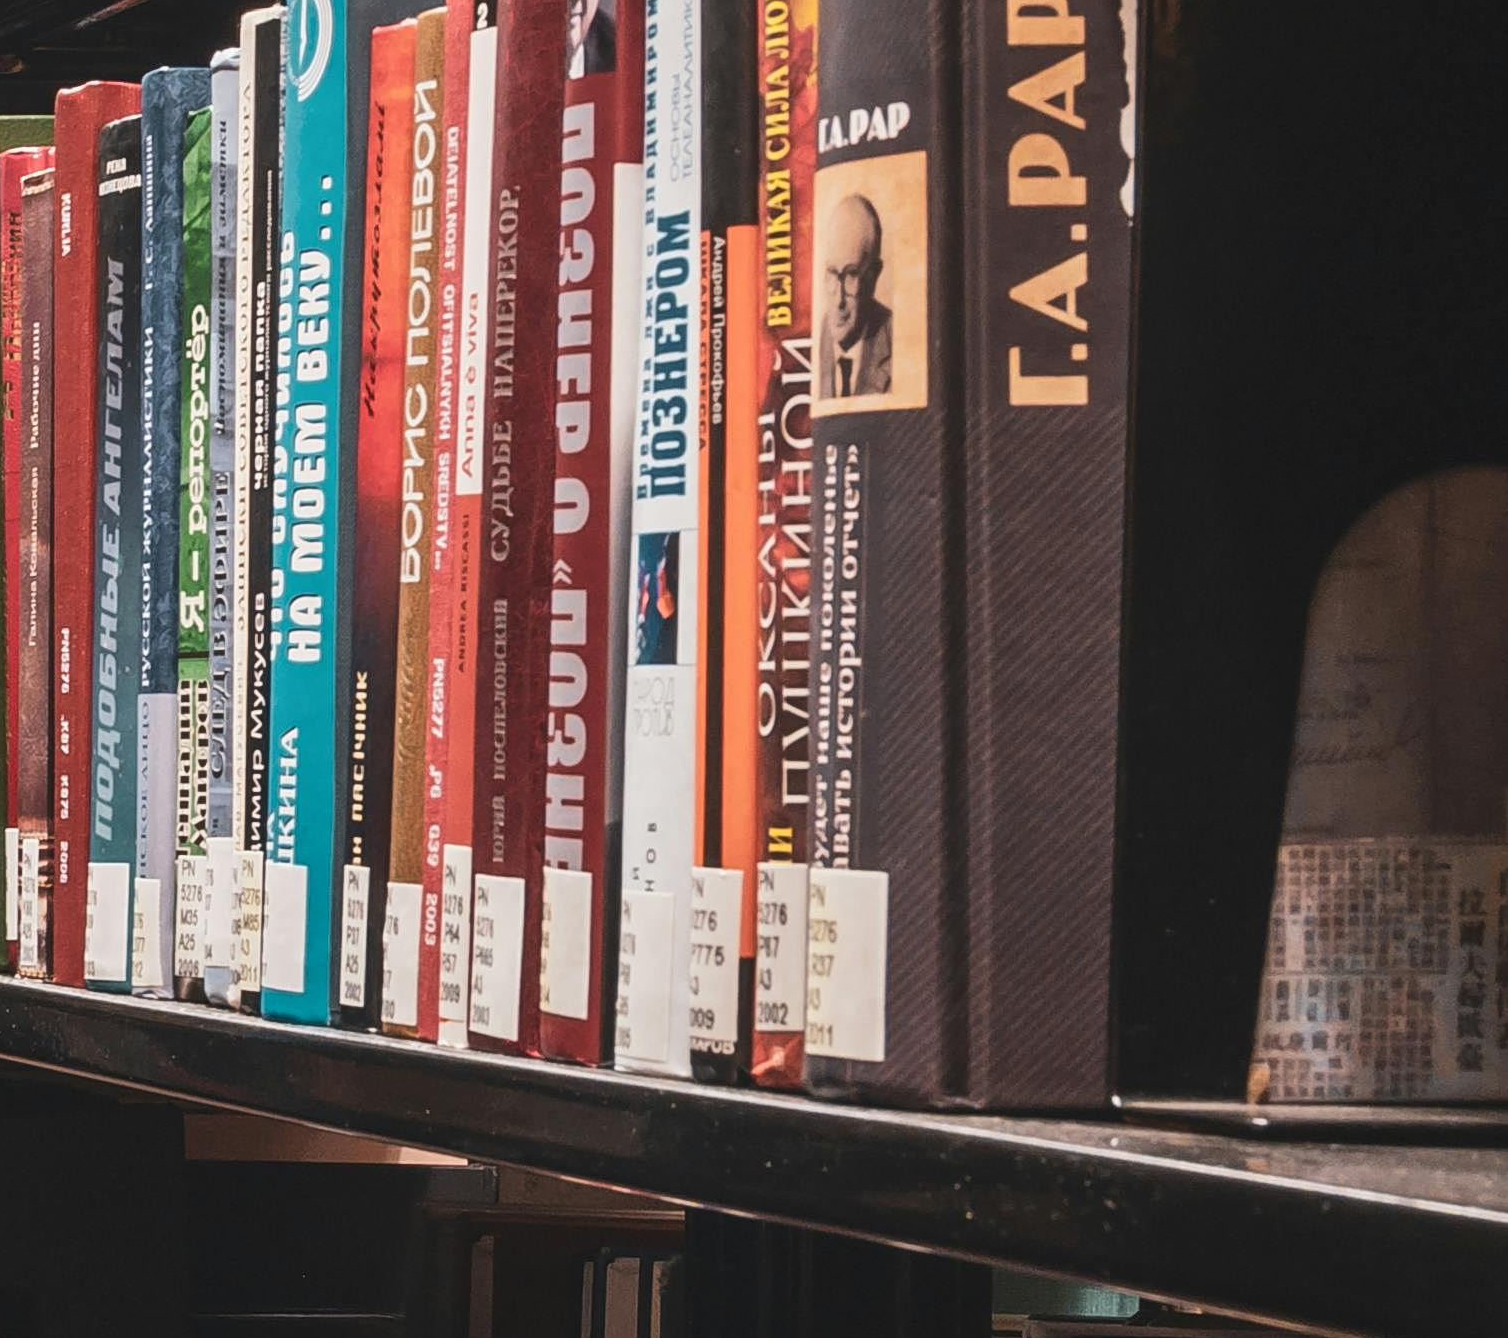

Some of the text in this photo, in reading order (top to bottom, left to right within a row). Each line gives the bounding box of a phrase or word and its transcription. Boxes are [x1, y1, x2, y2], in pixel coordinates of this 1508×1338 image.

[764, 69, 791, 162] СИЛА
[399, 79, 439, 584] БОРИС ПОЛЕВОЙ
[438, 125, 460, 442] DEIATELNOST OFITSIALNYKH
[465, 291, 479, 357] viva
[554, 102, 596, 455] ПОЗНЕР
[708, 236, 726, 425] Андрей Прокофьев
[766, 168, 793, 328] ВЕЛИКАЯ
[253, 281, 267, 491] черная папка
[459, 399, 478, 480] Anna
[647, 209, 691, 502] ПОЗНЕРОМ
[94, 255, 125, 842] ПОДОБНЫЕ АНГЕЛАМ
[140, 326, 155, 688] РУССКОЙ ЖУРНАЛИСТИКИ
[181, 302, 210, 633] Я репортёр
[290, 400, 327, 574] МОЕМ
[490, 419, 515, 566] СУДЬБЕ
[288, 591, 324, 663] НА
[756, 411, 777, 738] ОКСАНЫ
[780, 333, 814, 806] ПУШКИНОЙ
[815, 443, 839, 765] наше поколенье
[210, 666, 232, 780] СЛЕД
[250, 592, 268, 740] Мукусев
[432, 657, 447, 740] PN5277
[836, 589, 862, 761] истории
